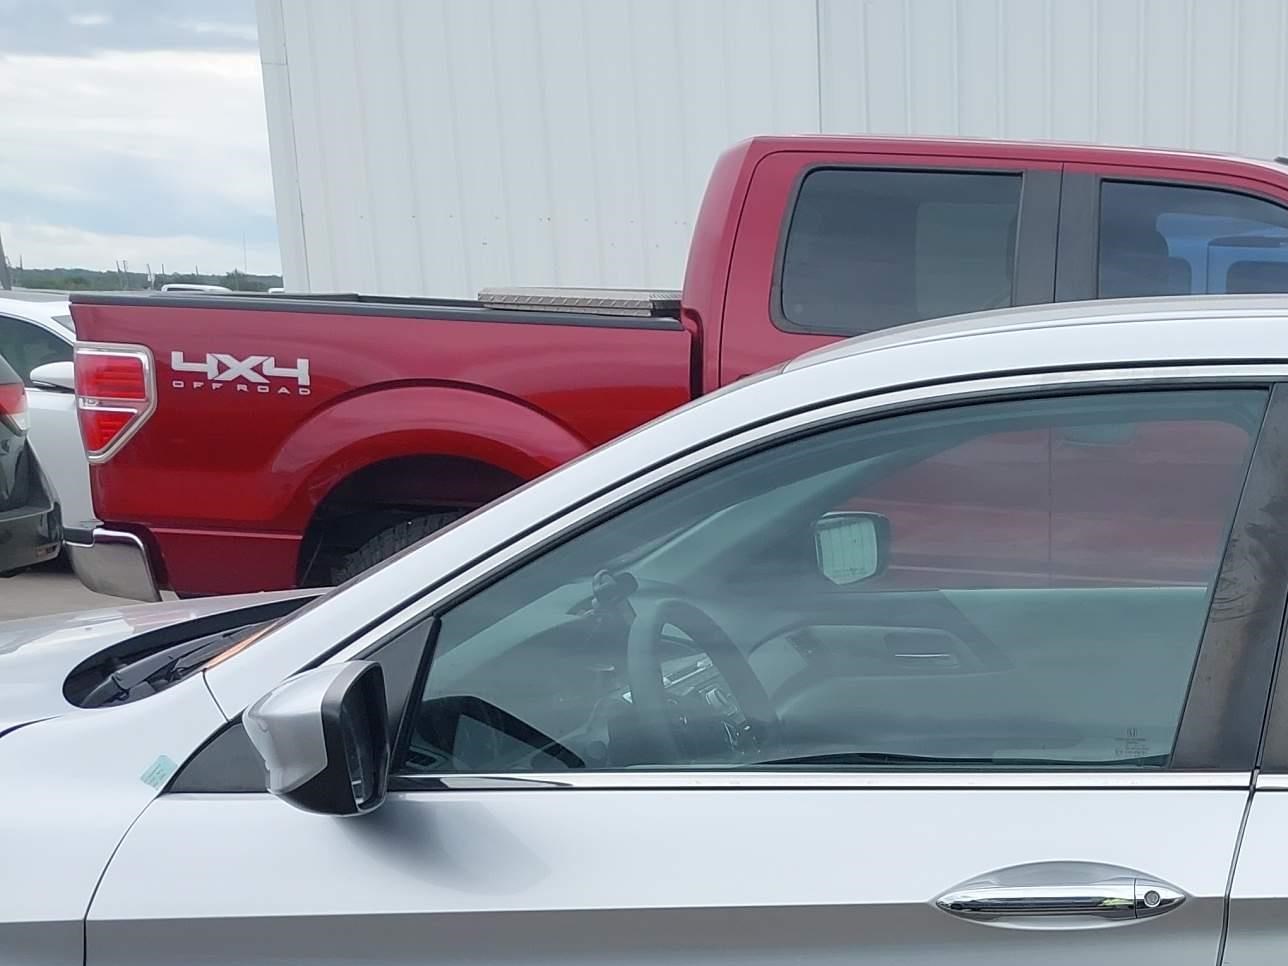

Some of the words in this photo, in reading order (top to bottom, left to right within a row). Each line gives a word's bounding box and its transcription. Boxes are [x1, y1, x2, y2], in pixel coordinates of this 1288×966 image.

[171, 351, 310, 386] 4X4
[172, 380, 223, 390] OFF
[236, 384, 311, 395] ROAD
